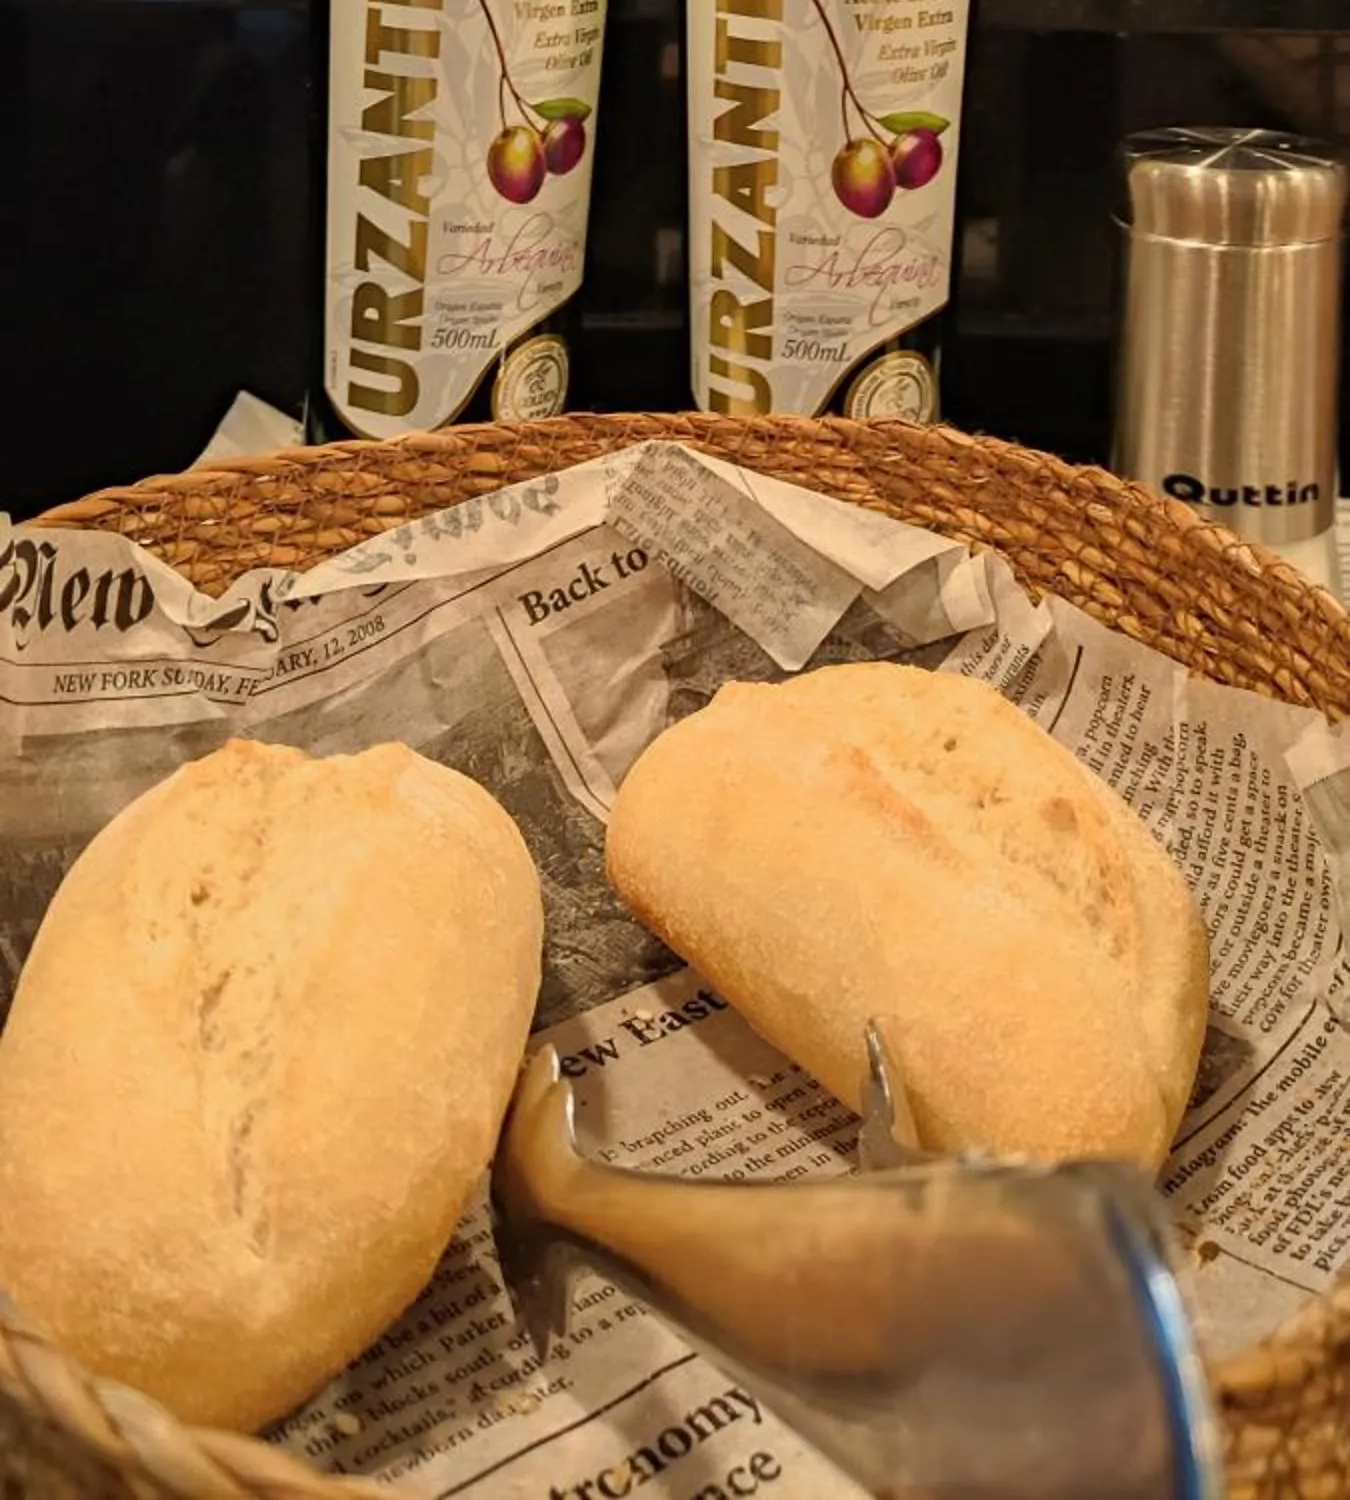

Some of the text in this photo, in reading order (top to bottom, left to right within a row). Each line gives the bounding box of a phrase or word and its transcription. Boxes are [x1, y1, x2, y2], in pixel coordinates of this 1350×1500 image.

[853, 12, 912, 34] Virgen
[431, 328, 502, 351] 500mL
[781, 338, 852, 363] 500mL
[1162, 473, 1320, 507] Quttin
[517, 562, 612, 627] Back
[610, 547, 650, 579] to
[53, 673, 97, 694] NEW
[101, 669, 159, 691] FORK
[164, 667, 231, 696] SUDAY,
[348, 614, 386, 647] 2008
[960, 652, 984, 676] this
[1084, 676, 1113, 743] popcorn
[1128, 684, 1152, 722] hear
[1096, 740, 1114, 758] in
[1124, 724, 1138, 742] to
[1144, 756, 1174, 792] With
[1190, 778, 1202, 796] to
[1232, 772, 1240, 782] a
[1247, 752, 1259, 801] space
[1186, 800, 1198, 820] so
[1196, 748, 1224, 862] afford it with
[1224, 786, 1238, 834] cents
[1244, 806, 1254, 816] a
[1278, 784, 1288, 808] on
[1212, 836, 1230, 868] five
[1240, 820, 1252, 848] get
[1274, 812, 1288, 864] snack
[1208, 872, 1222, 890] as
[1218, 768, 1270, 958] or outside a theater to
[1224, 850, 1246, 900] could
[1270, 870, 1280, 880] a
[1228, 884, 1278, 980] moviegoers
[1250, 950, 1278, 980] way
[1266, 912, 1288, 948] into
[1280, 878, 1296, 906] the
[1282, 892, 1312, 960] became
[1306, 876, 1314, 888] a
[1260, 1000, 1286, 1034] cow
[1278, 974, 1304, 1000] for
[560, 988, 730, 1077] ew East
[716, 1092, 748, 1110] out.
[1164, 1118, 1248, 1194] nstagram:
[1276, 1036, 1328, 1092] mobile
[652, 1140, 694, 1166] nced
[742, 1110, 762, 1122] to
[764, 1088, 806, 1112] open
[746, 1132, 768, 1144] to
[1228, 1144, 1268, 1180] food
[1294, 1100, 1314, 1116] to
[744, 1154, 776, 1172] the
[808, 1154, 832, 1168] in
[1272, 1234, 1292, 1254] of
[1284, 1190, 1332, 1236] FDL's
[1290, 1244, 1312, 1260] to
[1308, 1210, 1344, 1242] take
[464, 1284, 486, 1306] of
[569, 1327, 593, 1345] to
[598, 1318, 613, 1331] a
[370, 1350, 436, 1390] which
[438, 1312, 506, 1354] Parker
[366, 1382, 440, 1422] blocks
